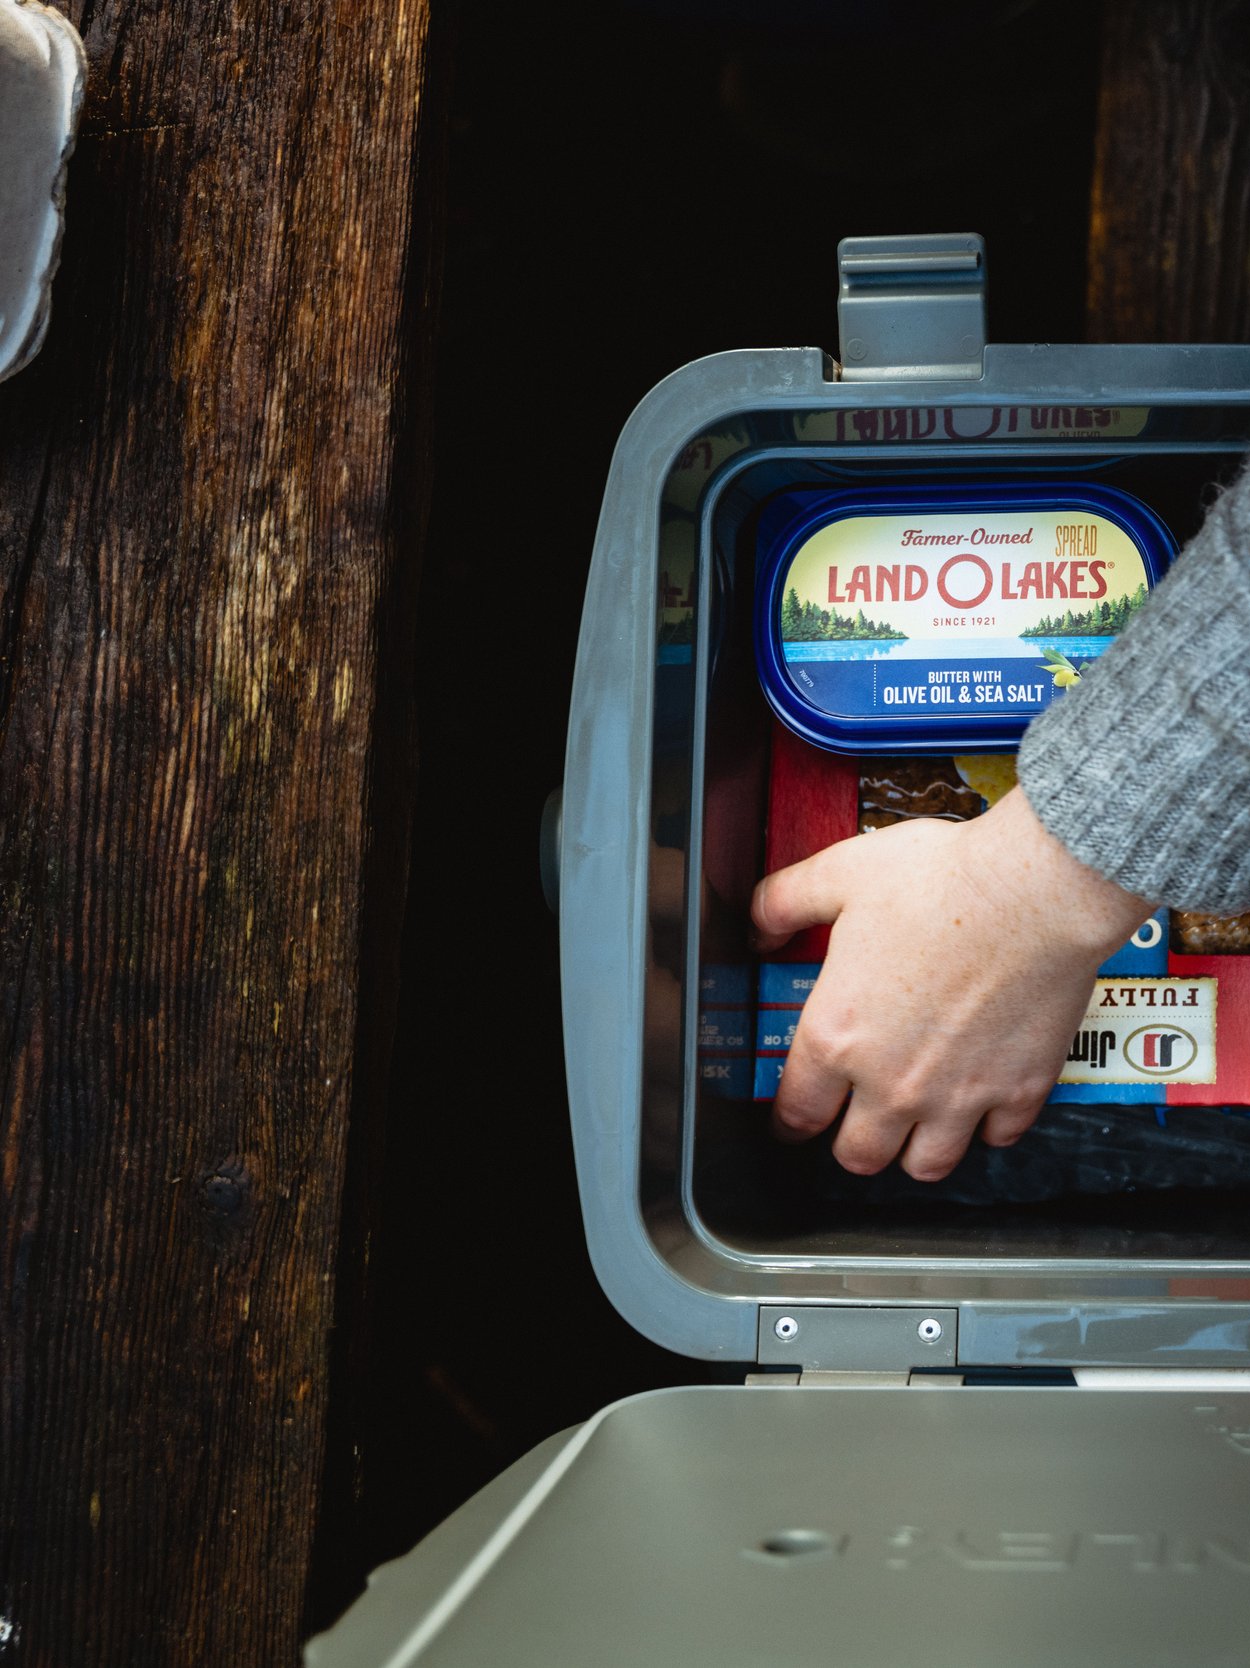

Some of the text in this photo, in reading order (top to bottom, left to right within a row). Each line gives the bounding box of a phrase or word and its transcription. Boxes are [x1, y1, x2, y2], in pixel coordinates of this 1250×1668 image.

[901, 527, 1033, 546] Farmer-Owned
[1055, 524, 1097, 557] SPREAD
[828, 564, 928, 603] LAND
[937, 554, 993, 609] O
[933, 616, 995, 626] SINCE 1921
[928, 670, 1001, 683] BUTTER WITH
[884, 685, 1044, 704] OLIVE OIL & SEA SALT
[1100, 988, 1199, 1006] FULLY
[764, 1035, 781, 1045] OR
[1066, 1030, 1116, 1068] Jim
